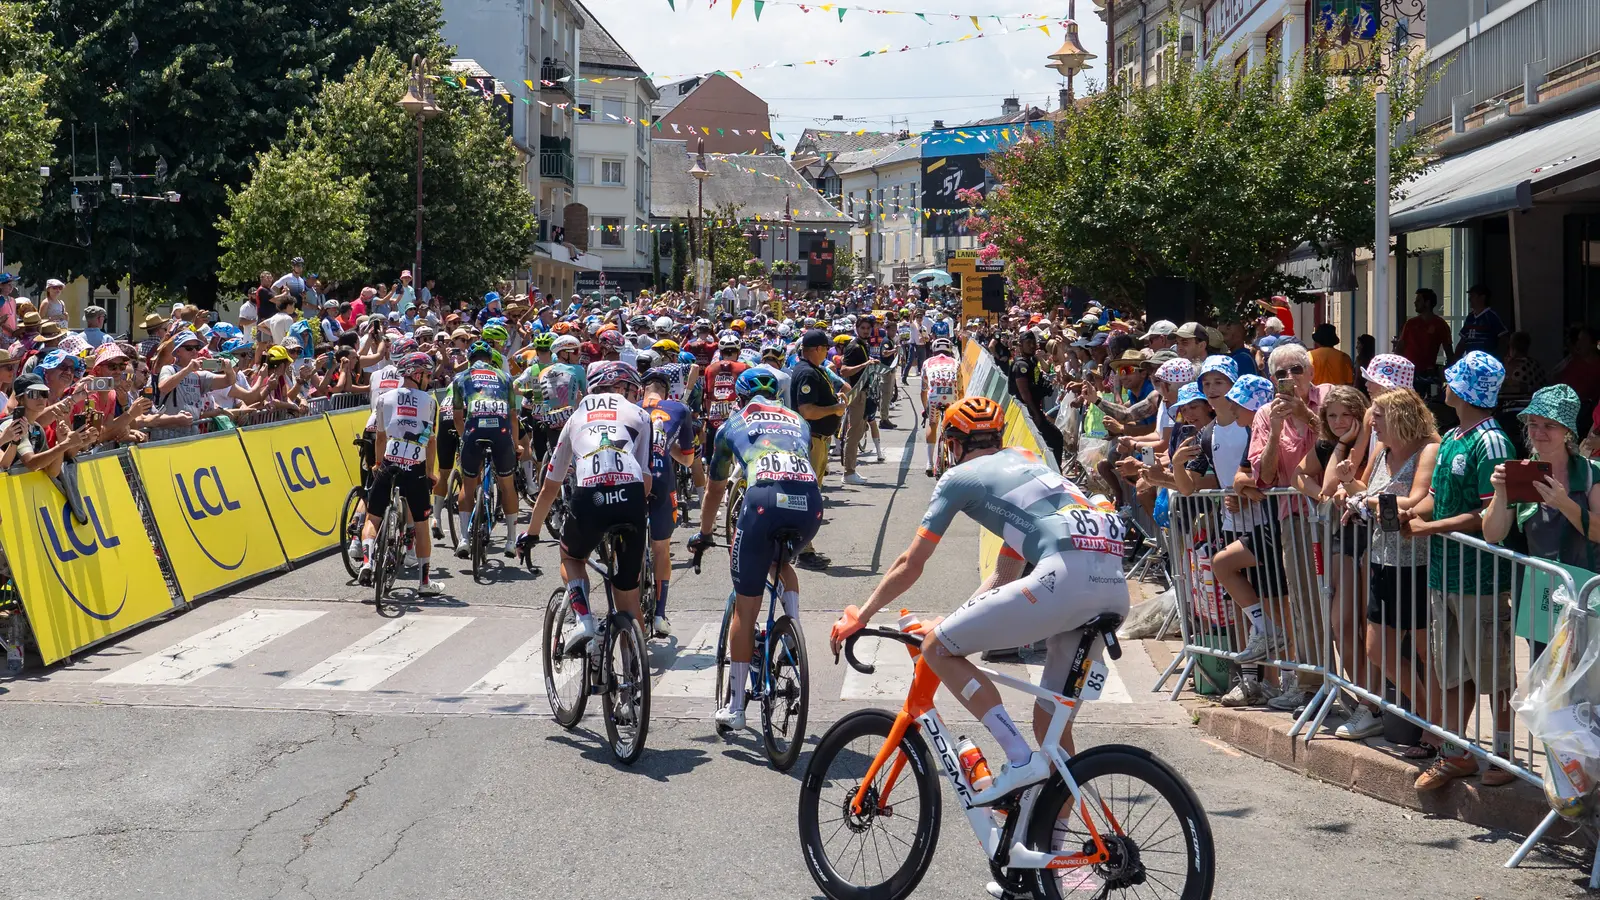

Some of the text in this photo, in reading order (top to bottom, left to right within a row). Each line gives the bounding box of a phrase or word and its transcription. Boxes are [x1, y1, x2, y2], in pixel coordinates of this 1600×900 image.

[472, 374, 498, 382] SOUDAL
[397, 394, 418, 407] UAE
[474, 400, 505, 413] 94 94
[585, 397, 618, 412] UAE
[745, 411, 800, 427] SOUDAL
[748, 427, 802, 437] QUICK-STEP
[391, 441, 421, 460] 8 8
[276, 446, 331, 492] LCL
[592, 451, 624, 475] 6 6
[760, 454, 808, 474] 96 96
[607, 473, 634, 482] VELUX
[175, 466, 241, 520] LCL
[605, 488, 628, 505] IHC
[984, 501, 1038, 534] Netcompany
[1070, 509, 1100, 537] 85
[39, 496, 121, 562] LCL
[732, 530, 743, 571] SOUDAL
[1073, 537, 1106, 550] VELUX
[1072, 648, 1085, 672] INEOS
[1087, 671, 1105, 691] 85
[904, 738, 925, 775] SCOPE
[923, 718, 974, 810] DOGMA
[1185, 816, 1201, 873] SCOPE
[806, 843, 829, 882] SCOPE
